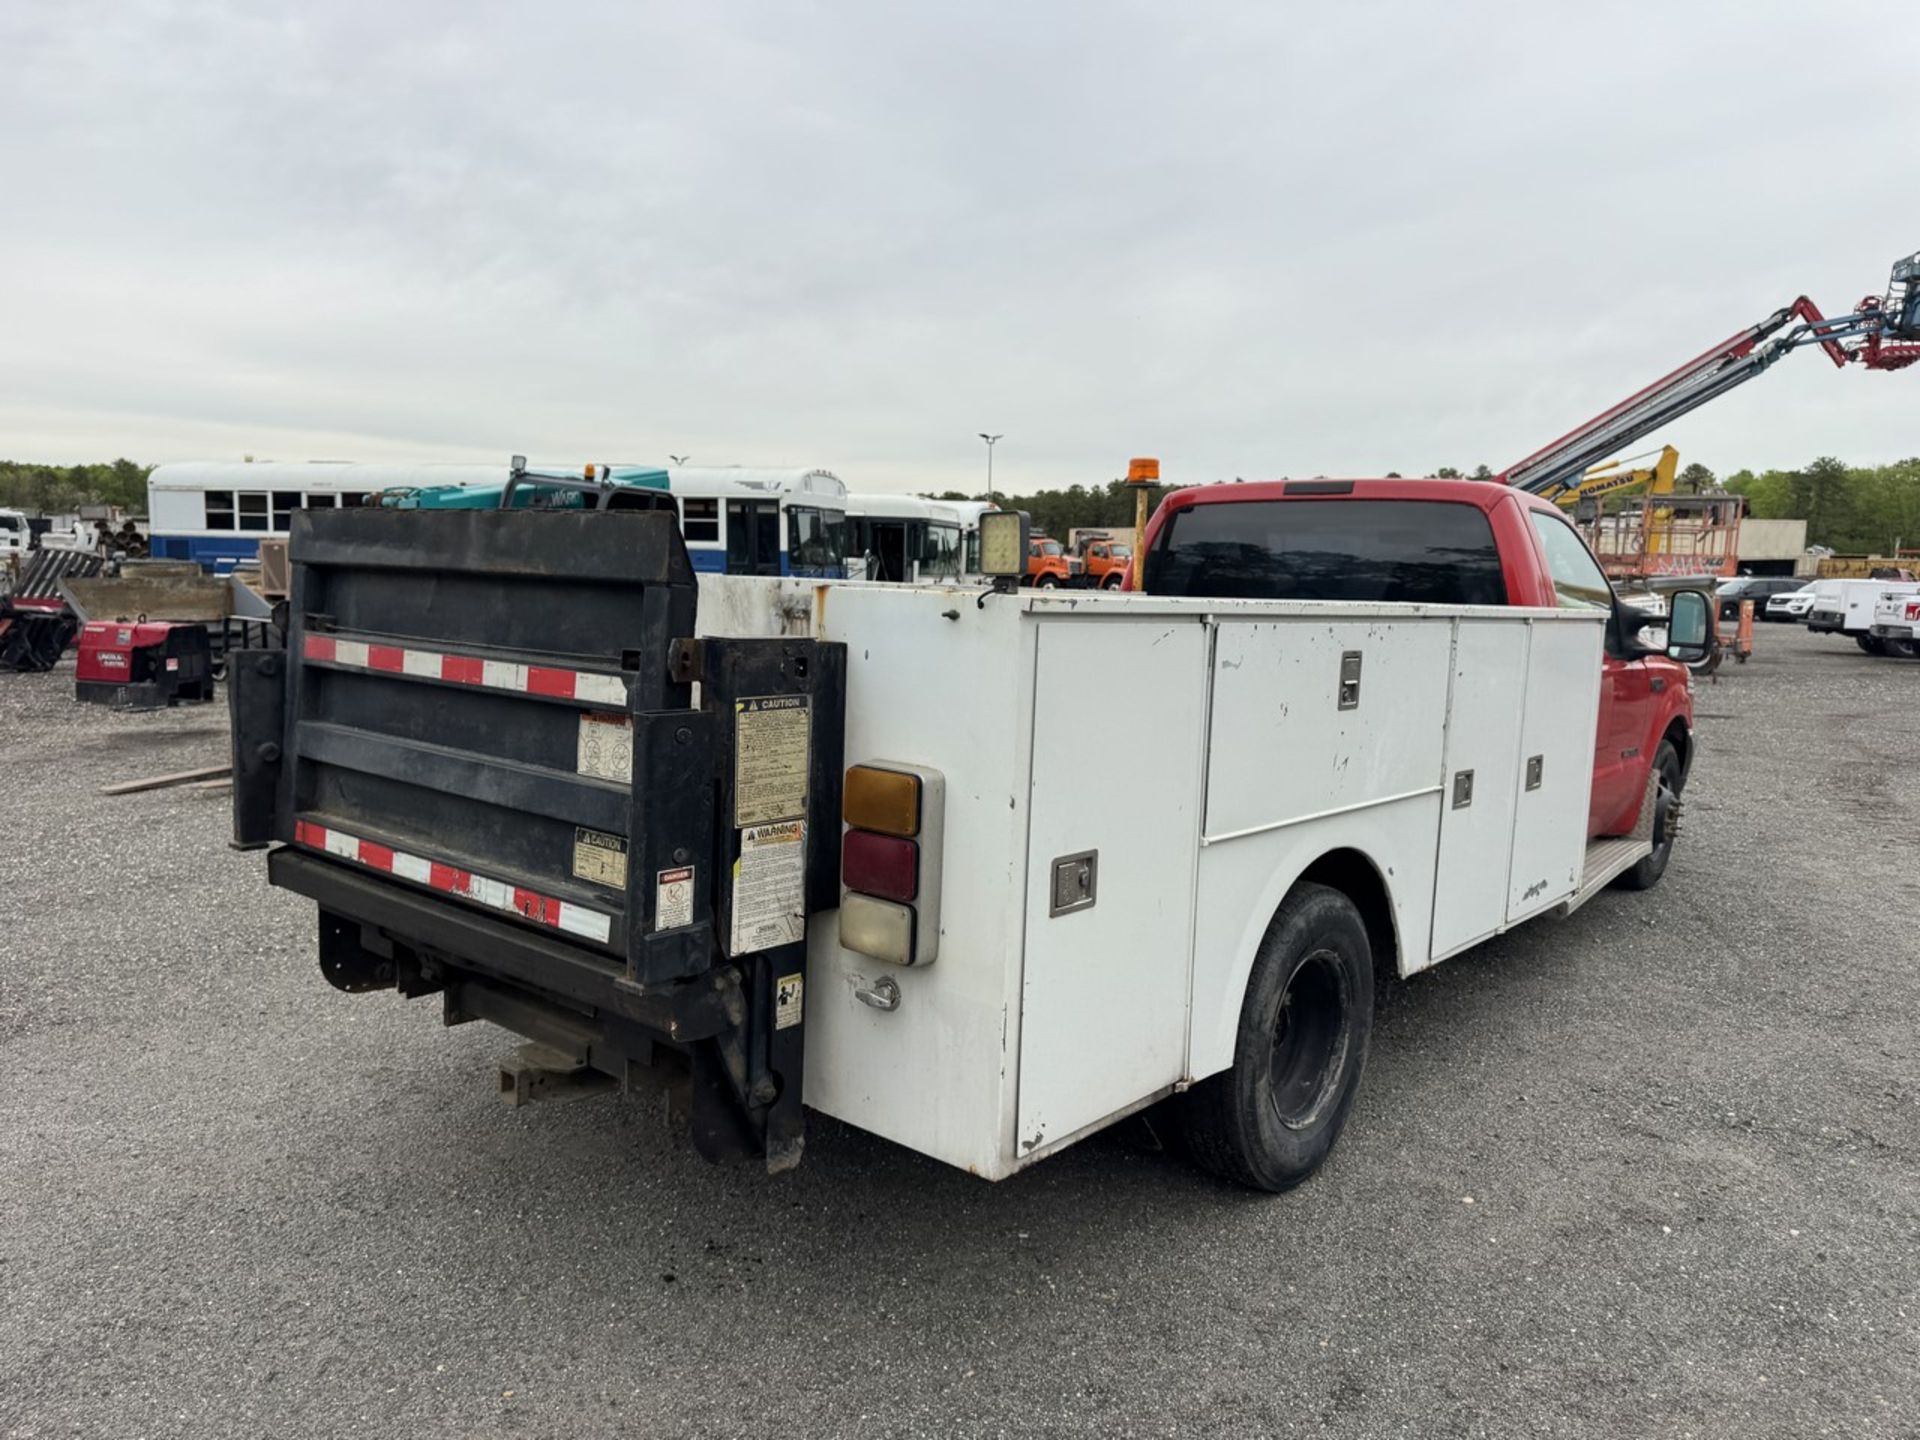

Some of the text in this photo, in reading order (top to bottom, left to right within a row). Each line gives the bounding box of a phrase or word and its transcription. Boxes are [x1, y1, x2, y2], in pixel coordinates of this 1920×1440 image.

[1579, 475, 1635, 498] KOMATSU
[761, 698, 801, 710] CAUTION
[756, 823, 798, 839] WARNING
[591, 834, 621, 851] CAUTION
